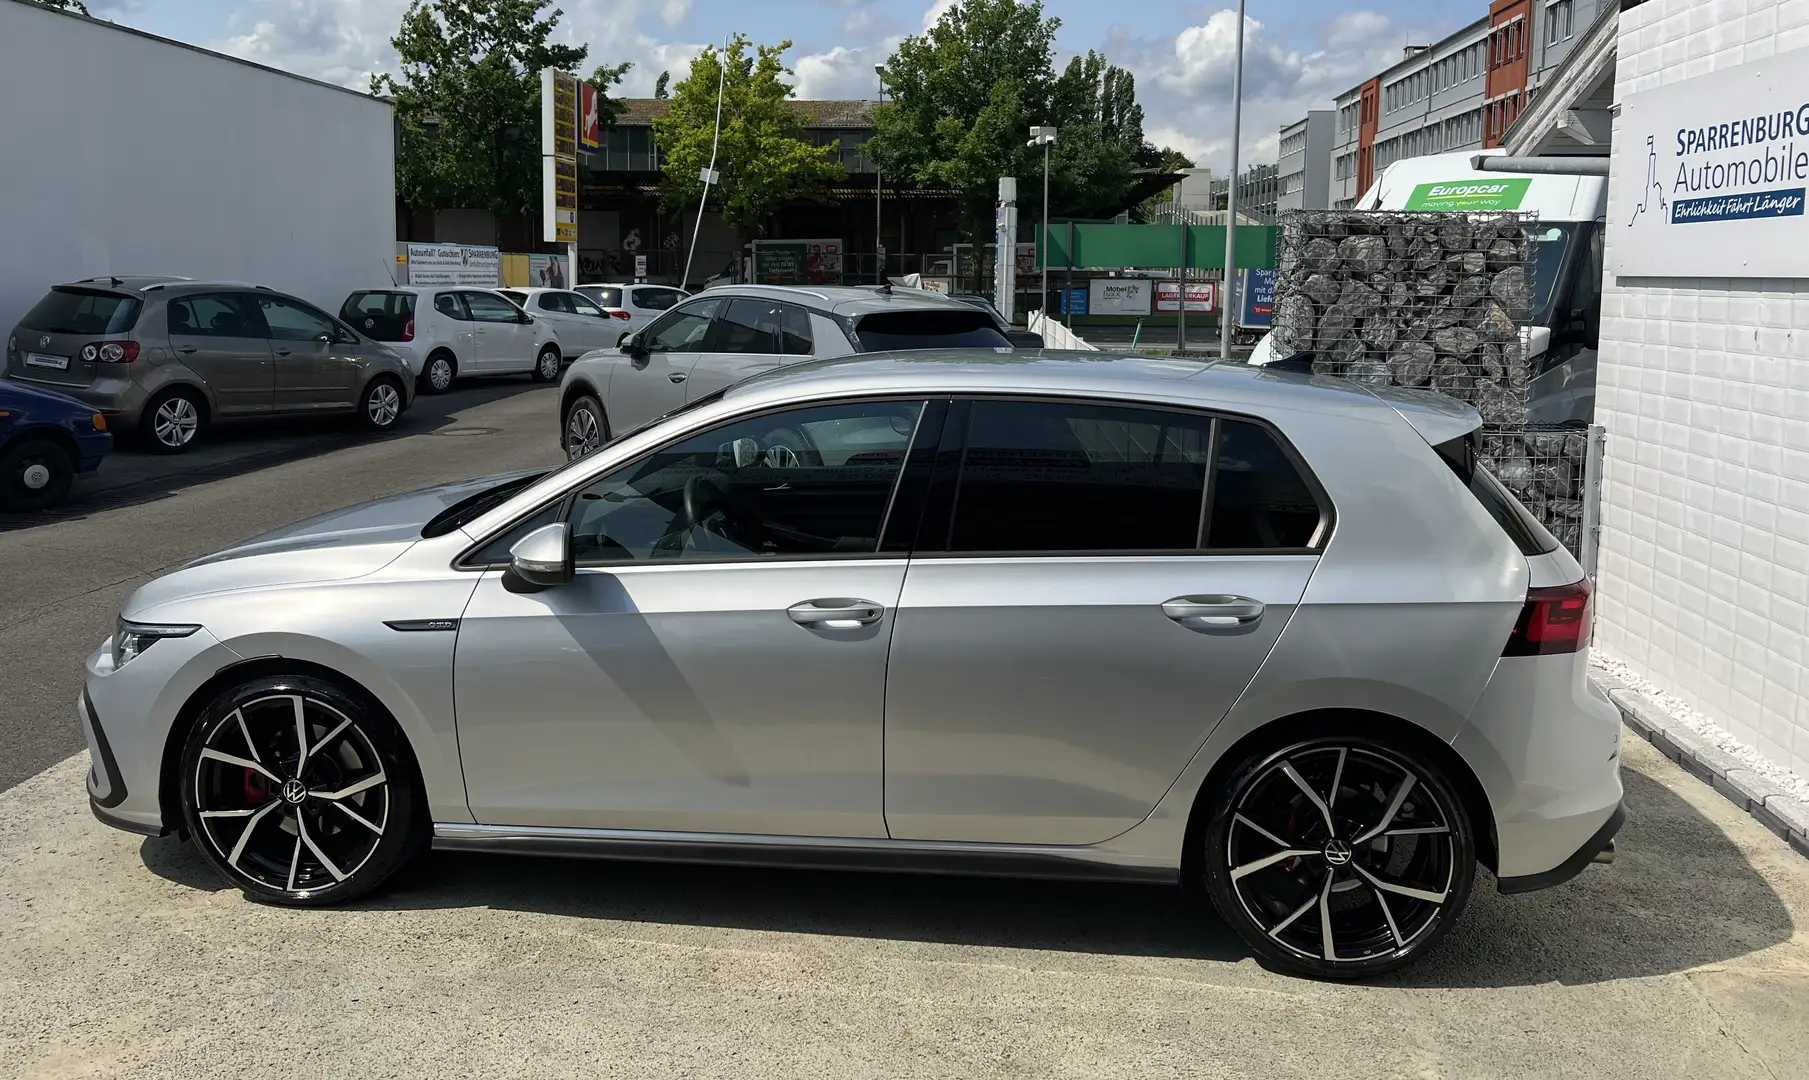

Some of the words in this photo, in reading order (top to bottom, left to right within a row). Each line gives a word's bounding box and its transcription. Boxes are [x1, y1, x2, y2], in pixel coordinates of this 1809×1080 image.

[1676, 103, 1809, 157] SPARRENBURG
[1673, 142, 1809, 194] Automobile
[1428, 184, 1509, 197] Europcar
[1675, 199, 1726, 218] Ehrlichkeit
[1725, 197, 1754, 215] Fährt
[1753, 195, 1802, 214] Länger
[1255, 268, 1271, 277] Spar
[1254, 286, 1266, 294] mit
